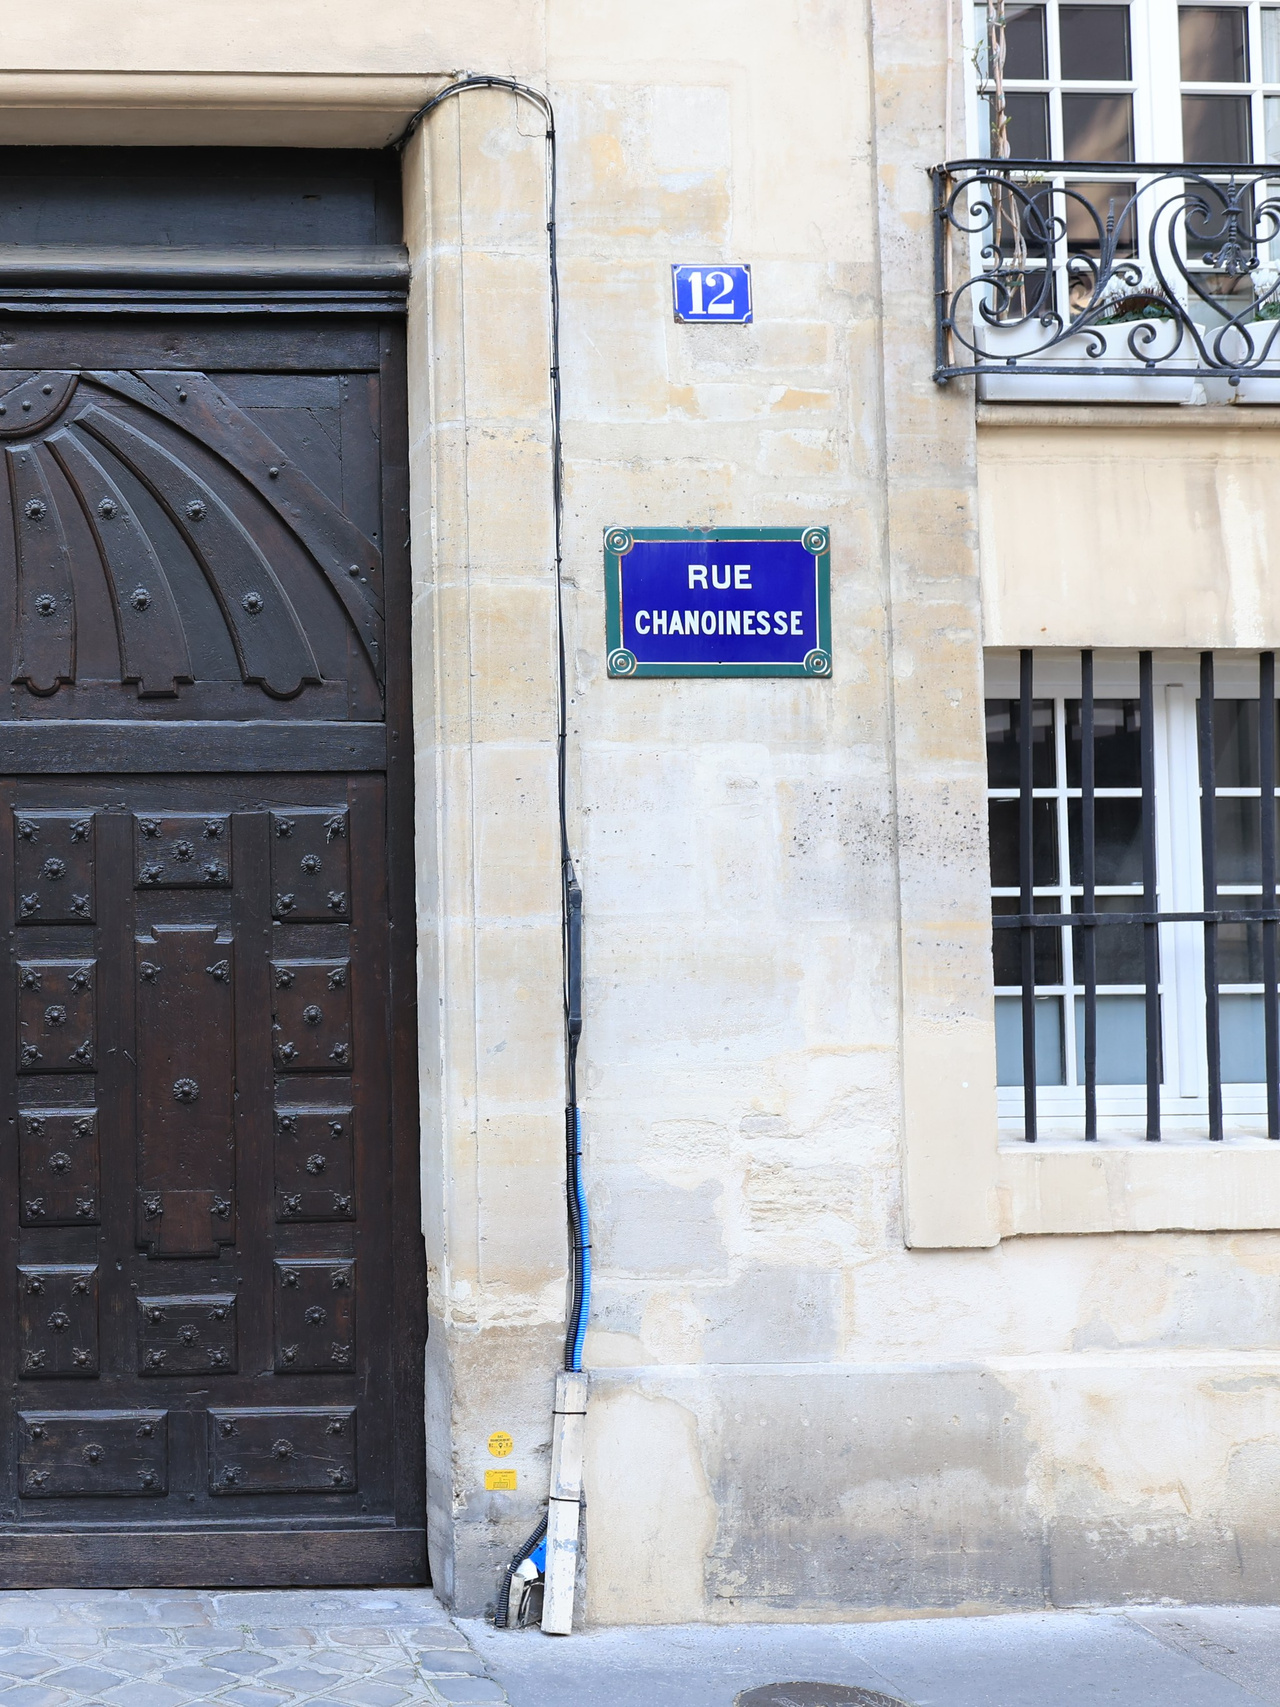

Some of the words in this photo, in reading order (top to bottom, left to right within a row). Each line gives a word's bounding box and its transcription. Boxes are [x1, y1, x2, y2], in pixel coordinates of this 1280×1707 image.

[688, 271, 734, 314] 12
[688, 564, 752, 589] RUE
[635, 610, 803, 635] CHANOINESSE
